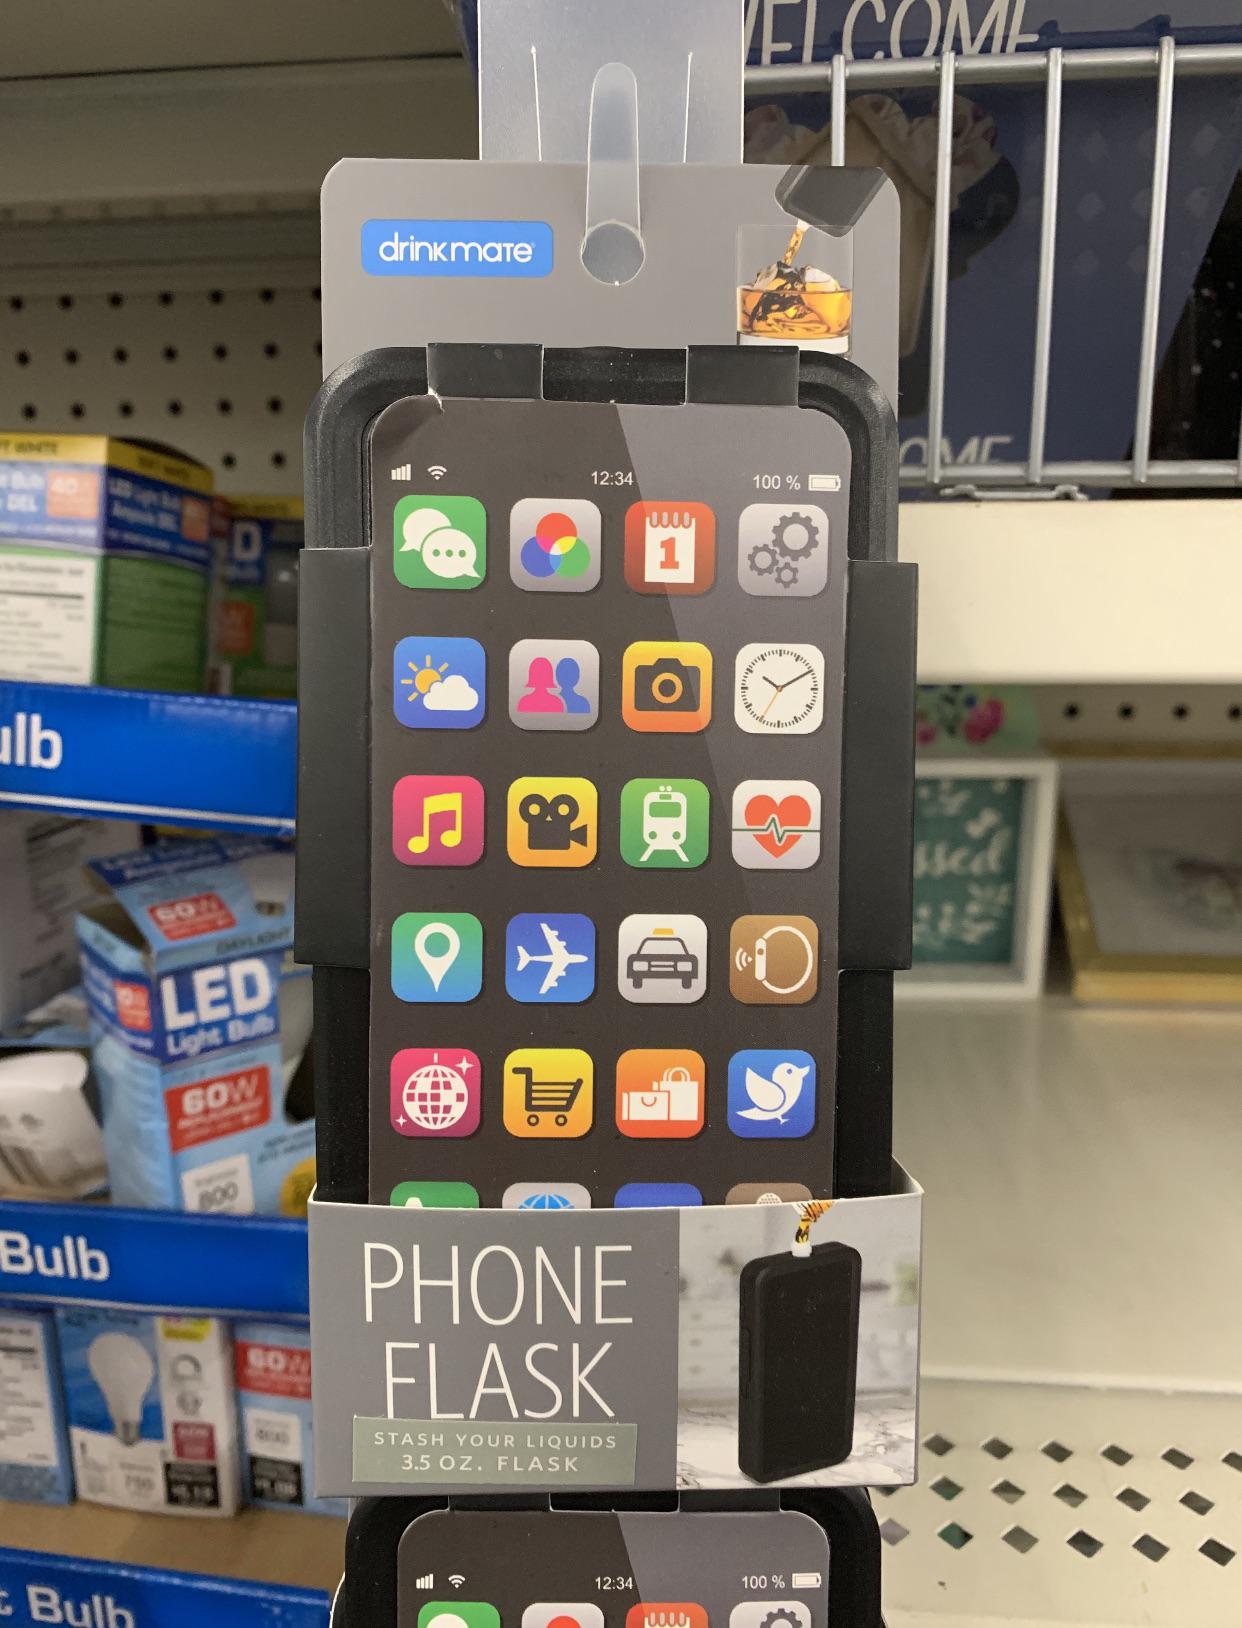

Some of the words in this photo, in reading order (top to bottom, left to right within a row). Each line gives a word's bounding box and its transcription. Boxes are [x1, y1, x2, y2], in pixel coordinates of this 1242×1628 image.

[378, 231, 534, 263] drinkmate
[590, 470, 635, 487] 12:34
[752, 474, 781, 490] 100
[785, 475, 801, 490] %
[659, 536, 680, 570] 1
[160, 959, 273, 1031] LED
[166, 1026, 224, 1057] Light
[182, 1073, 259, 1116] 60W
[0, 1226, 110, 1281] Bulb
[362, 1241, 634, 1327] PHONE
[384, 1341, 616, 1419] FLASK
[373, 1431, 445, 1447] STASH
[455, 1433, 515, 1448] YOUR
[526, 1434, 617, 1449] LIQUIDS
[400, 1454, 431, 1471] 3.5
[439, 1455, 483, 1471] OZ.
[497, 1455, 580, 1472] FLASK
[594, 1576, 634, 1591] 12:34
[741, 1575, 768, 1589] 100
[771, 1575, 786, 1589] %
[25, 1583, 136, 1628] Bulb
